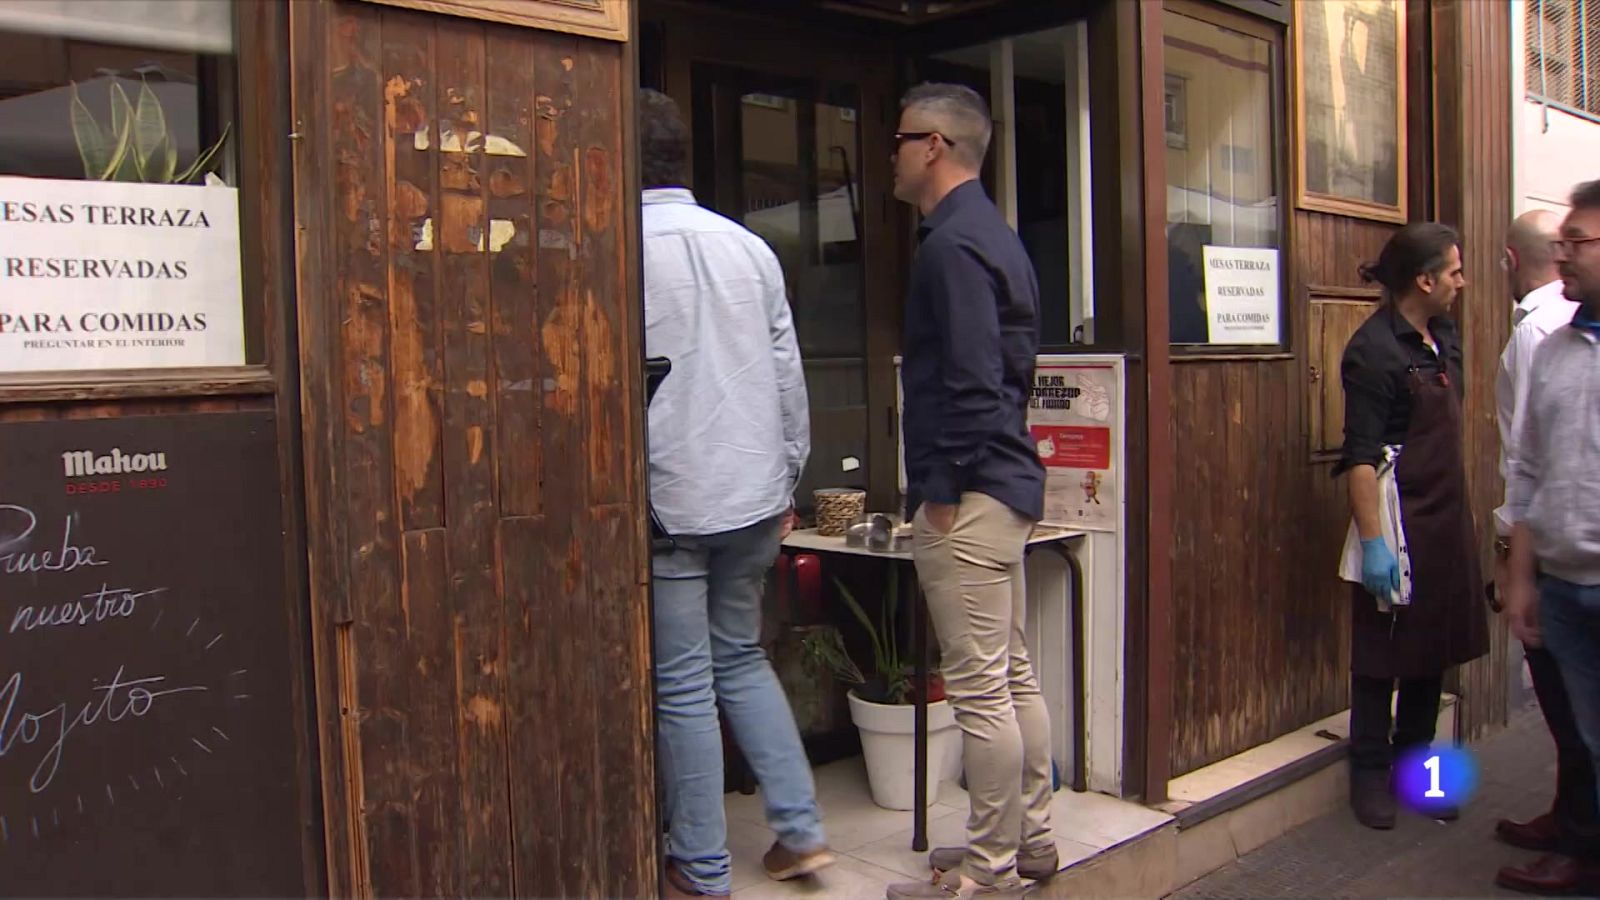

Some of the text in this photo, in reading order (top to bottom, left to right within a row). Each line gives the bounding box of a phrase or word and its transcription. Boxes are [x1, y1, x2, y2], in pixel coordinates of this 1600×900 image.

[3, 201, 210, 228] ESAS TERRAZA
[6, 257, 188, 280] RESERVADAS
[1209, 258, 1270, 271] MESAS TERRAZA
[1217, 286, 1265, 297] RESERVADAS
[0, 312, 207, 333] PARA COMIDAS
[1217, 312, 1270, 324] PARA COMIDAS
[24, 338, 185, 349] PREGUNTAR EN EL INTERIOR
[62, 447, 167, 477] Mahou
[65, 478, 167, 496] DESDE 1890
[9, 583, 170, 633] nuestro
